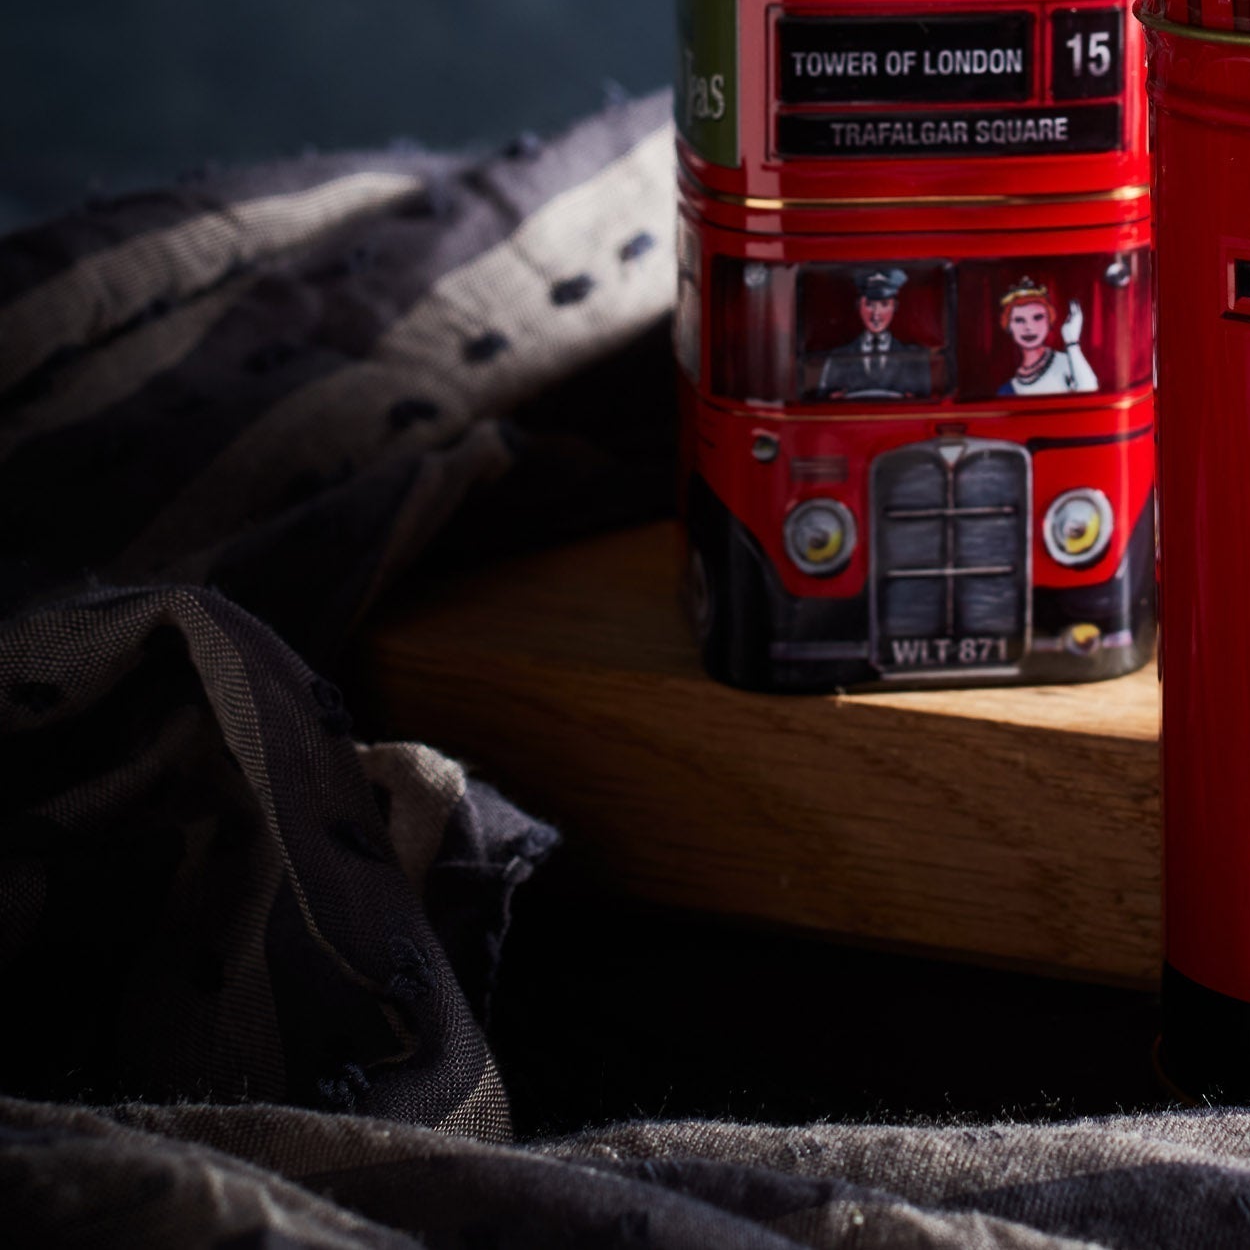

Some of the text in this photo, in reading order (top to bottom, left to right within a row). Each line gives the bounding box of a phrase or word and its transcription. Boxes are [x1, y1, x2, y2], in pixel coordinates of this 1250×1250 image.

[791, 49, 1023, 76] TOWER OF LONDON
[1066, 32, 1111, 77] 15
[830, 116, 1069, 146] TRAFALGAR SQUARE
[890, 637, 1008, 665] WLT 871
